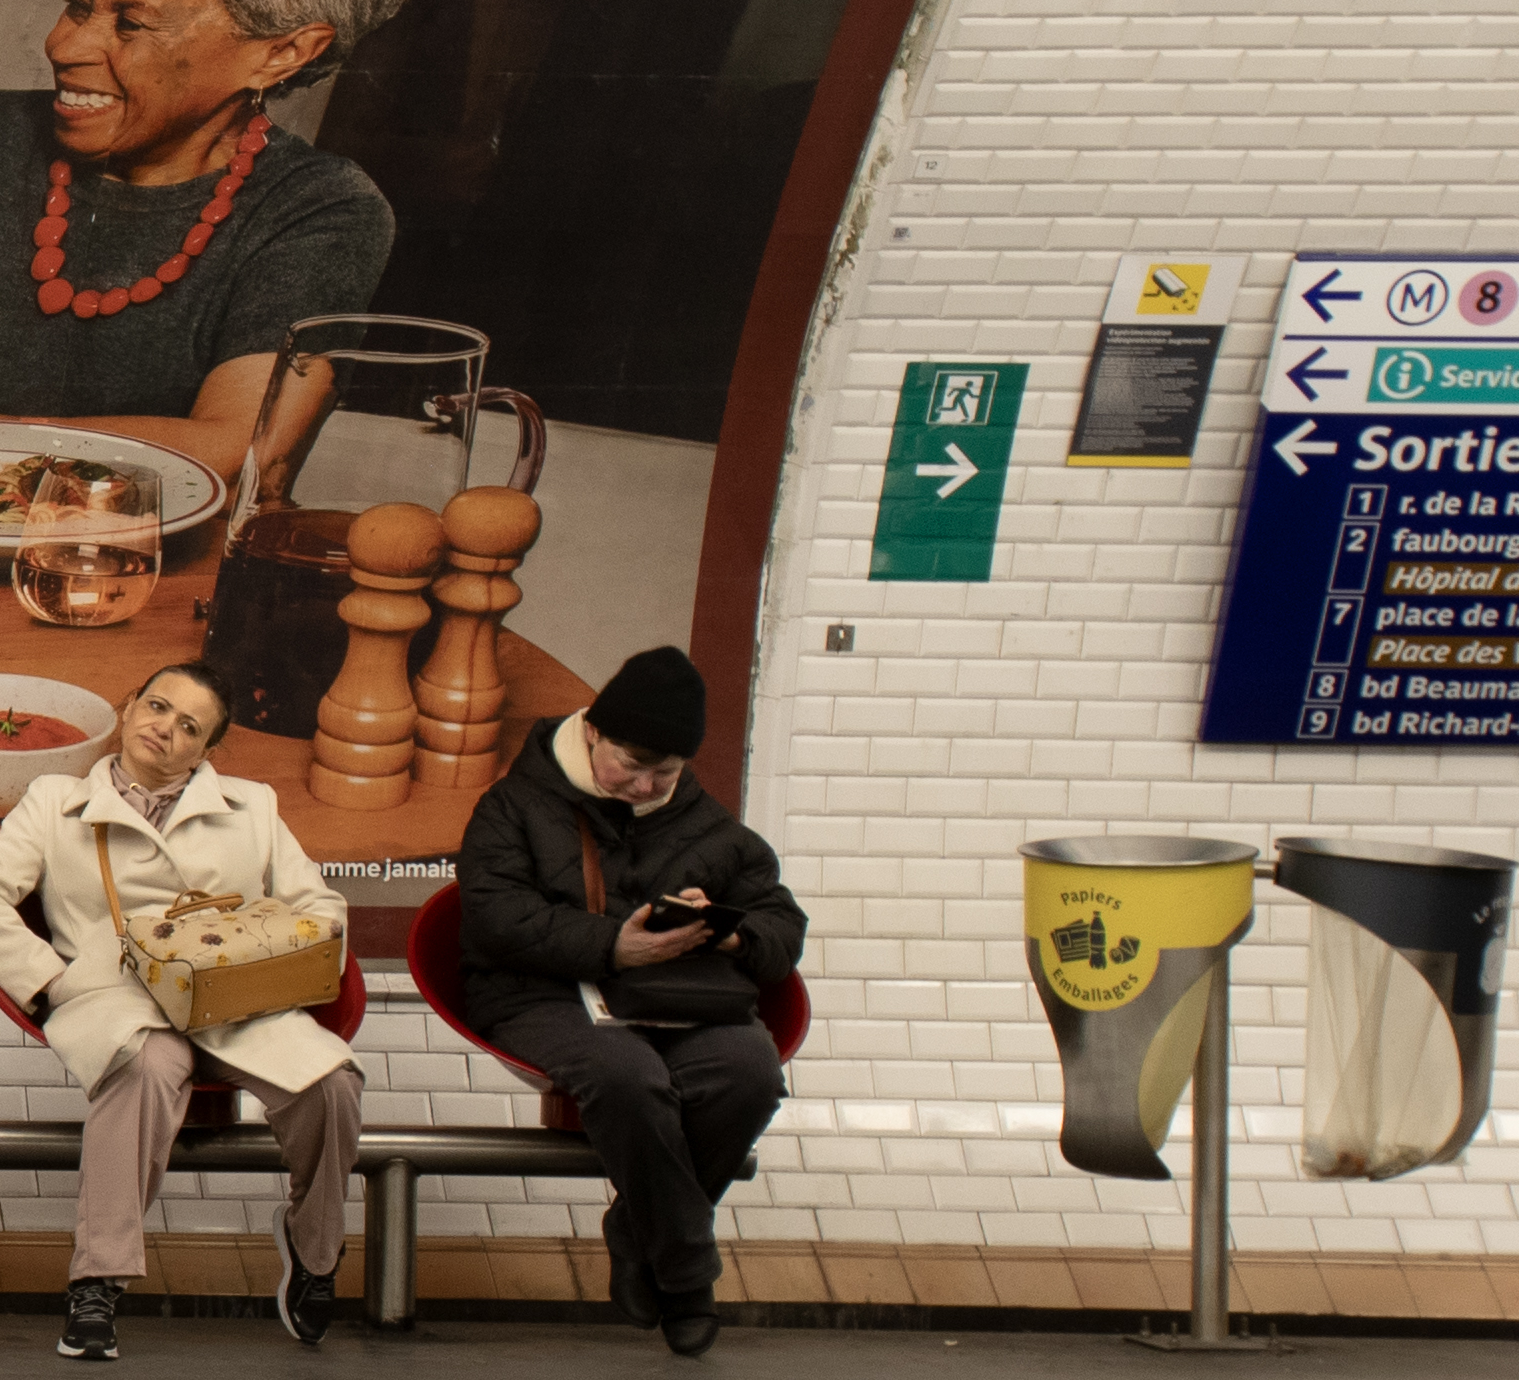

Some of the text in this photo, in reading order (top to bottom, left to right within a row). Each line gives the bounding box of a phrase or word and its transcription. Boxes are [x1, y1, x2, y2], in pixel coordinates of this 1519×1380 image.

[1475, 280, 1503, 314] 8
[1352, 424, 1519, 472] Sortie
[1358, 491, 1373, 513] 1
[1398, 494, 1417, 515] r.
[1423, 490, 1462, 515] de
[1468, 490, 1498, 516] la
[1346, 527, 1519, 559] 2 faubourg
[1390, 565, 1501, 595] Hôpital
[1333, 601, 1352, 625] 7
[1375, 601, 1454, 631] place
[1460, 603, 1499, 627] de
[1372, 638, 1451, 663] Place
[1456, 641, 1507, 664] des
[1316, 674, 1336, 697] 8
[1359, 674, 1400, 699] bd
[1309, 710, 1328, 733] 9
[1351, 710, 1391, 735] bd
[383, 857, 457, 882] jamais
[1060, 887, 1122, 910] Papiers
[1052, 967, 1139, 1002] Emballages
